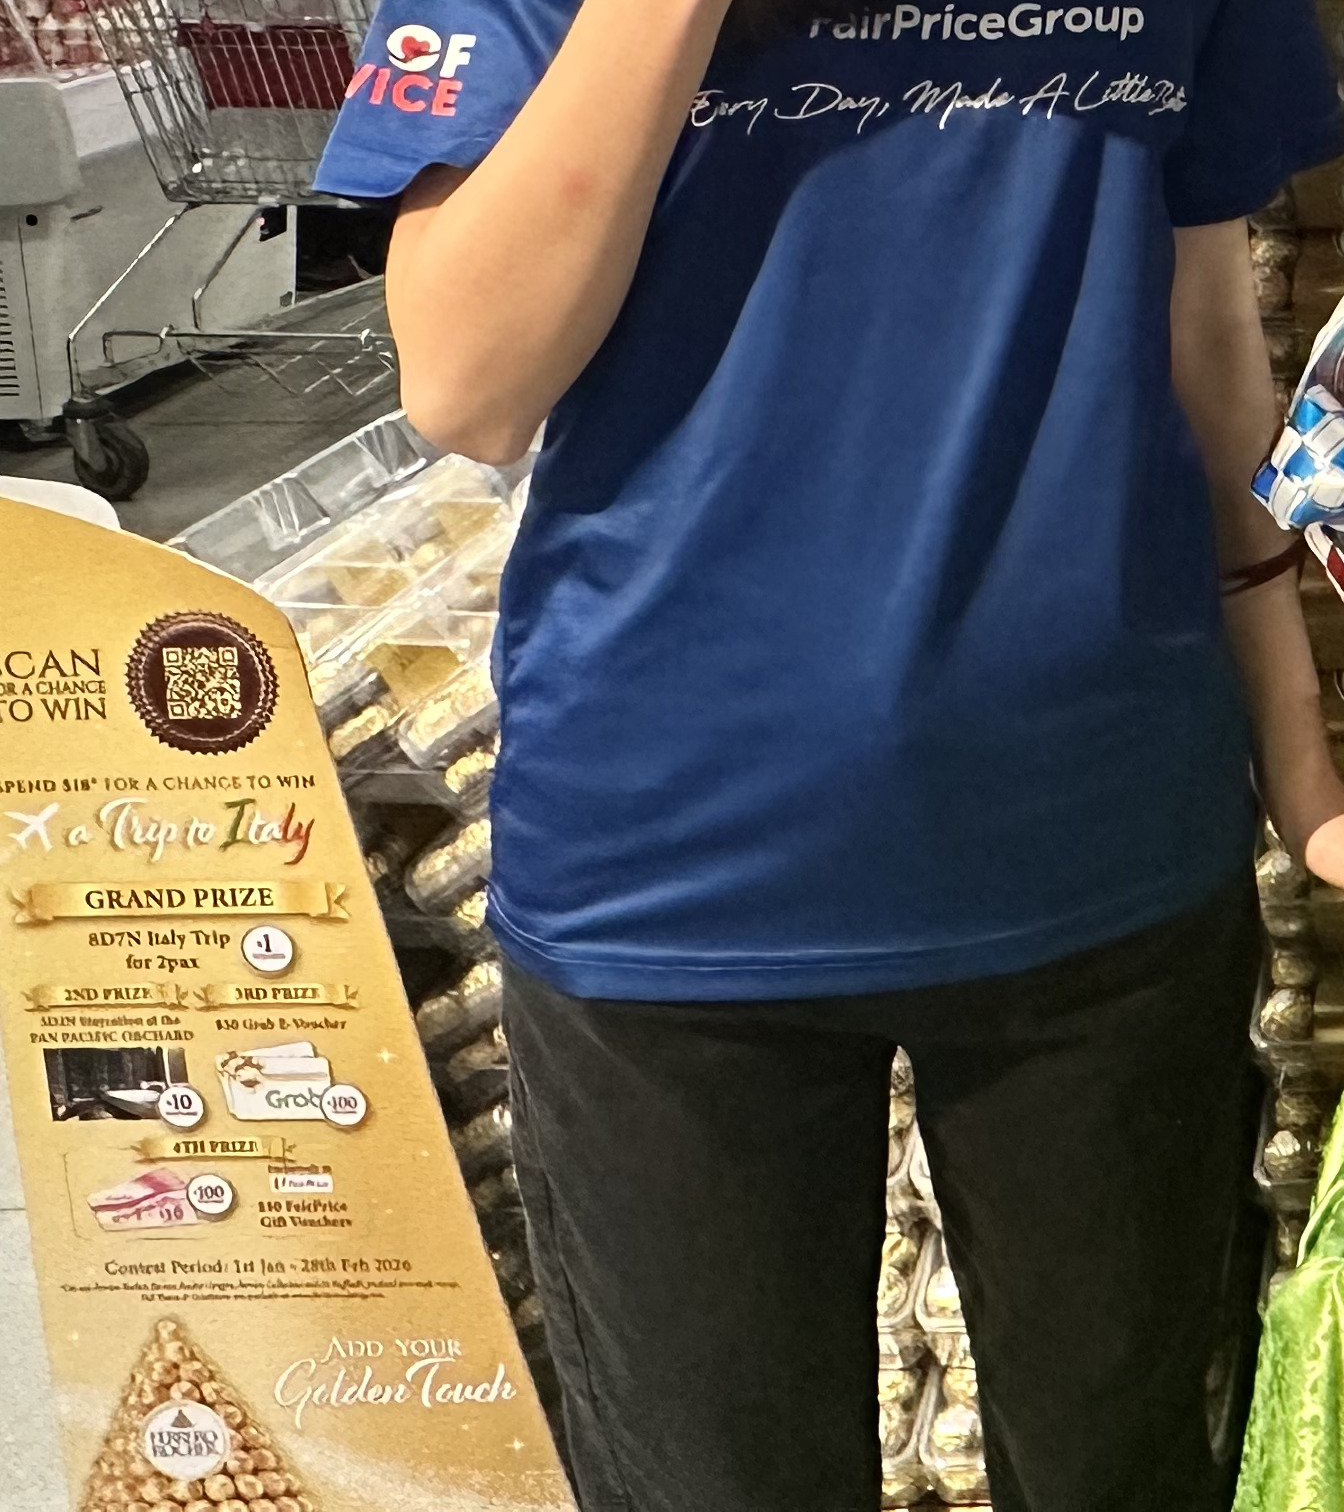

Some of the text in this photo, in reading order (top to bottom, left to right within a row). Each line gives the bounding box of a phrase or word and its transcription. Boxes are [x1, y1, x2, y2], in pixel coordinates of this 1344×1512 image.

[1020, 72, 1071, 120] A
[0, 648, 102, 680] CAN
[22, 681, 34, 695] A
[35, 679, 107, 696] CHANCE
[40, 697, 107, 722] WIN
[145, 777, 160, 791] A
[163, 776, 242, 791] CHANCE
[246, 775, 271, 790] TO
[276, 775, 316, 789] WIN
[66, 796, 316, 866] a Trip to Italy
[85, 887, 275, 909] GRAND PRIZE
[148, 930, 186, 949] Italy
[190, 930, 231, 947] Trip
[126, 954, 153, 970] for
[103, 988, 153, 1001] PRIZE
[320, 1336, 463, 1364] ADD YOUR
[273, 1356, 518, 1430] Golden Touch
